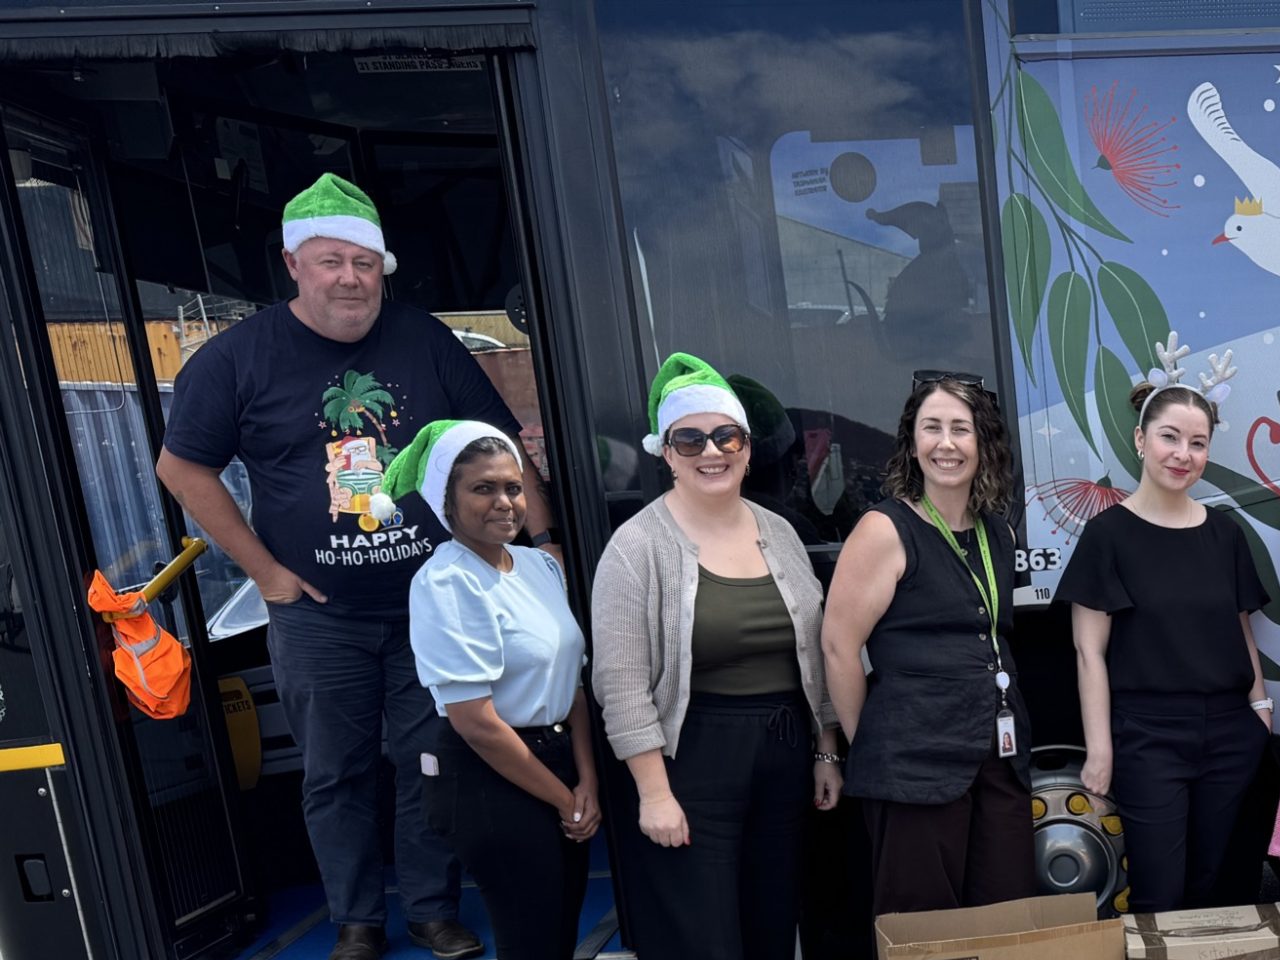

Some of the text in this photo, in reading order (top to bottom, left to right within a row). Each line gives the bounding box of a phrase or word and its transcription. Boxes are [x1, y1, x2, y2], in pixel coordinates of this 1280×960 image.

[330, 525, 419, 549] HAPPY
[315, 537, 433, 566] HO-HO-HOLIDAYS
[1035, 588, 1051, 601] 110
